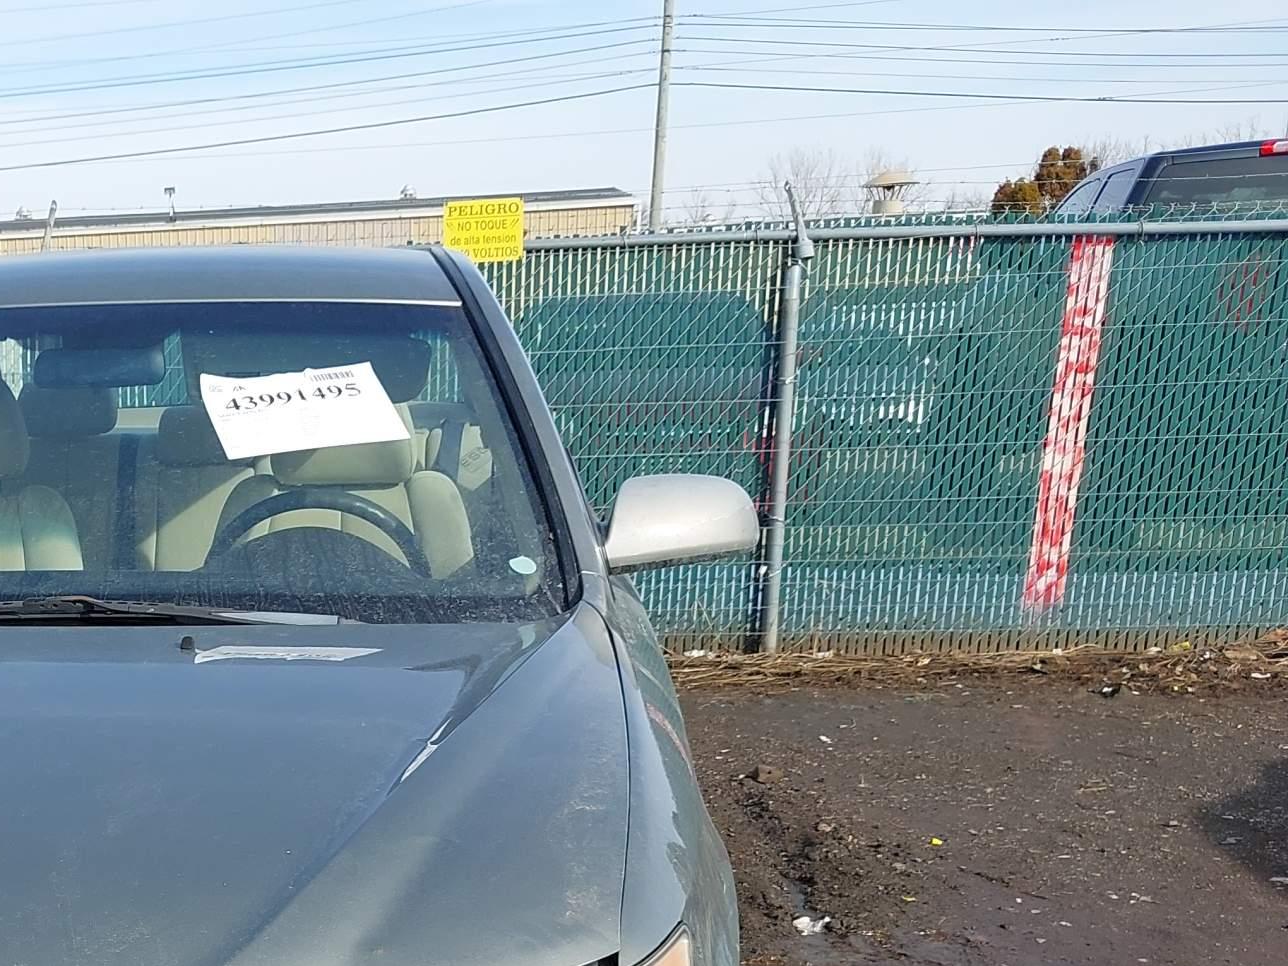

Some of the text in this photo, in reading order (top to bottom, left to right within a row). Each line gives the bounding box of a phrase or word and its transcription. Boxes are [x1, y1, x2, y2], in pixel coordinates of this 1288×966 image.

[447, 202, 520, 217] PELIGRO
[457, 219, 508, 232] NO TOQUE
[450, 236, 462, 247] de
[464, 235, 480, 246] alta
[473, 246, 519, 259] VOLTIOS
[224, 382, 362, 411] 43991495
